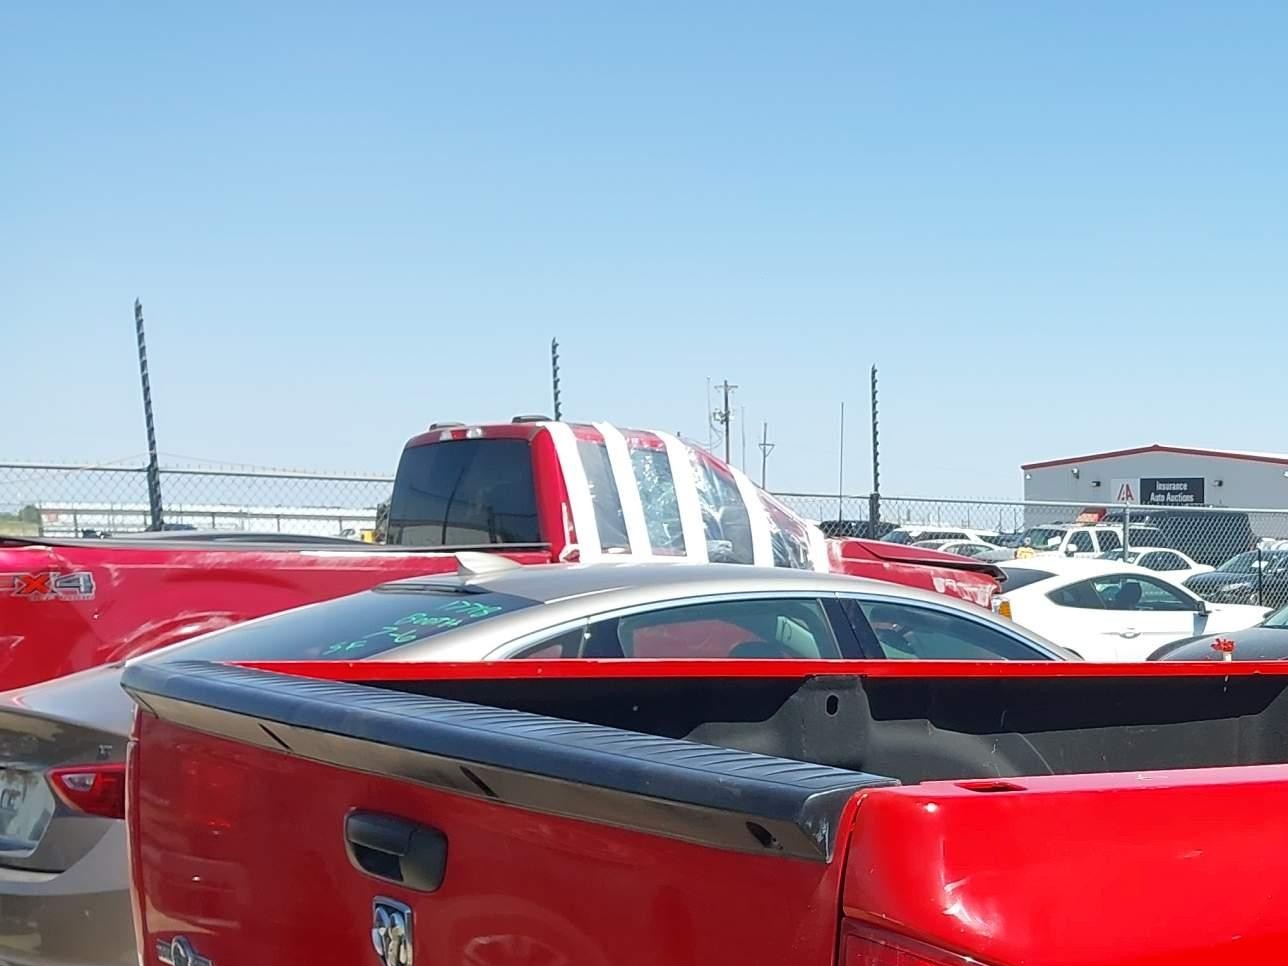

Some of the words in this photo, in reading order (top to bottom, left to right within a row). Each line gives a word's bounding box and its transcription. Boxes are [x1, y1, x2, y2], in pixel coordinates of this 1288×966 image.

[1155, 481, 1188, 491] Insurance
[1150, 492, 1165, 502] Auto
[1166, 492, 1194, 502] Auctions
